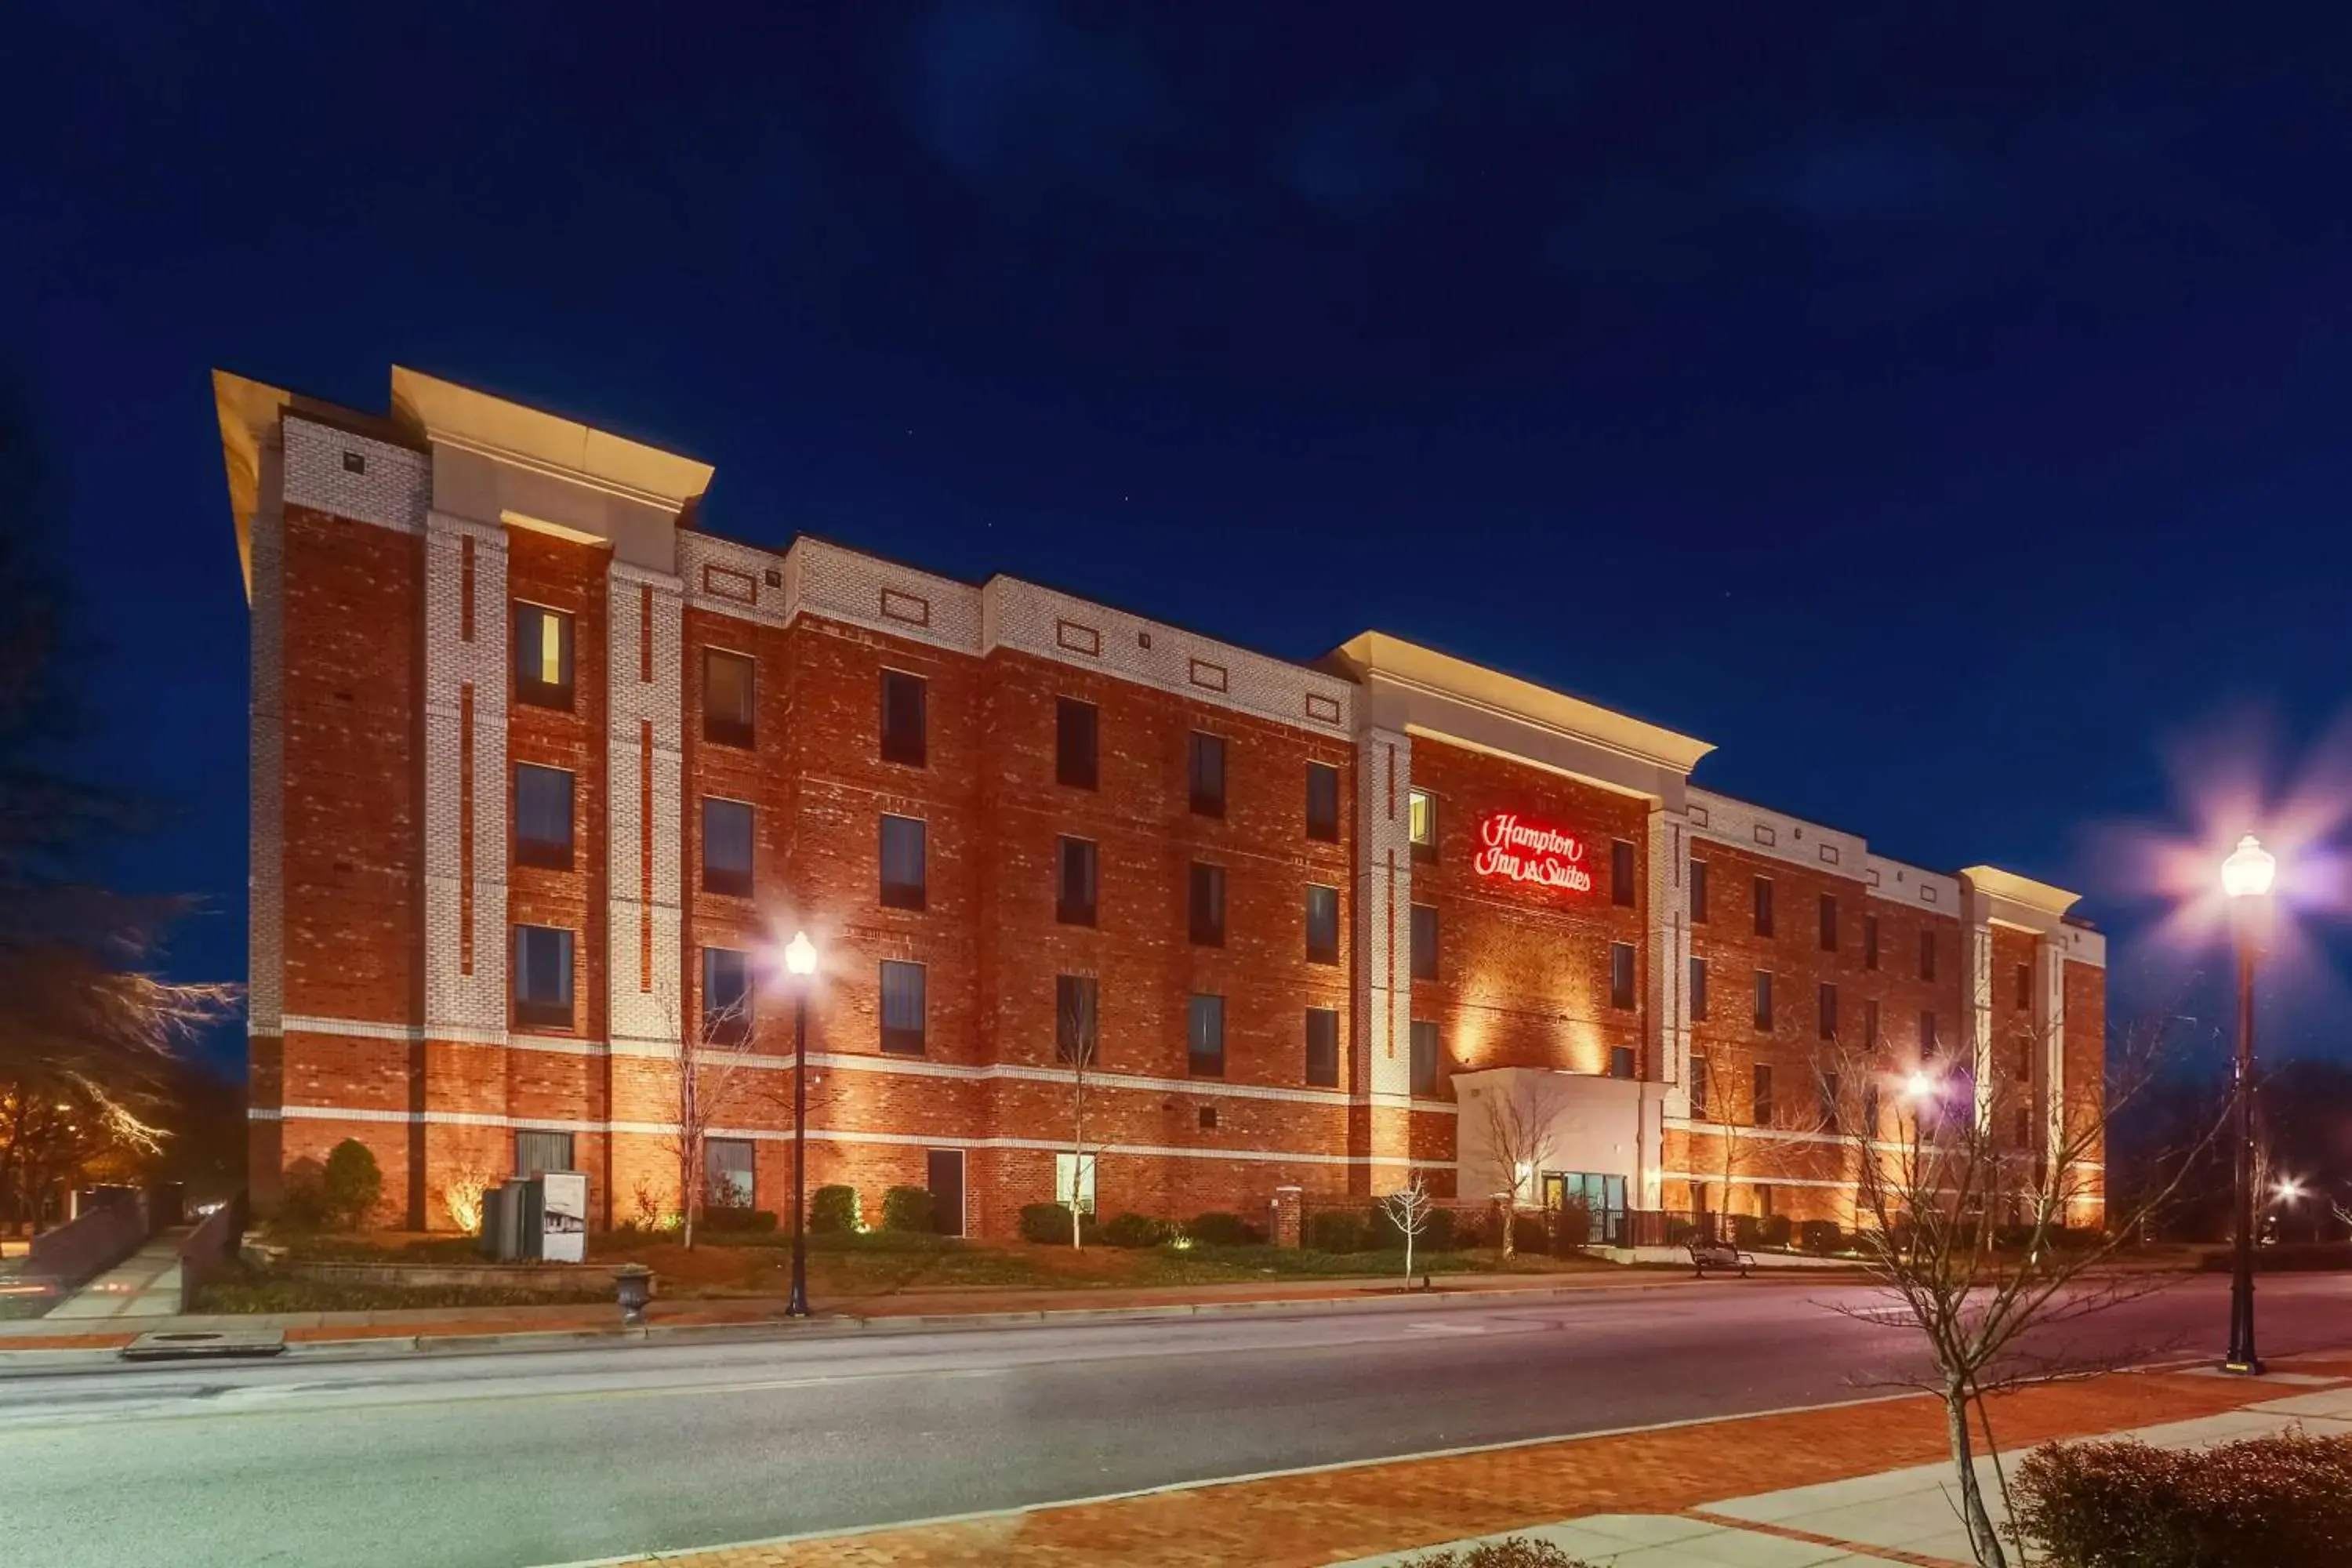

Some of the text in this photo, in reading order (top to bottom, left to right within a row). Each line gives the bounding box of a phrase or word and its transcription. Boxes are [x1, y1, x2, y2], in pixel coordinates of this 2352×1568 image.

[1482, 815, 1582, 861] Hampton
[1475, 847, 1528, 881] Inn
[1539, 858, 1591, 891] Suites
